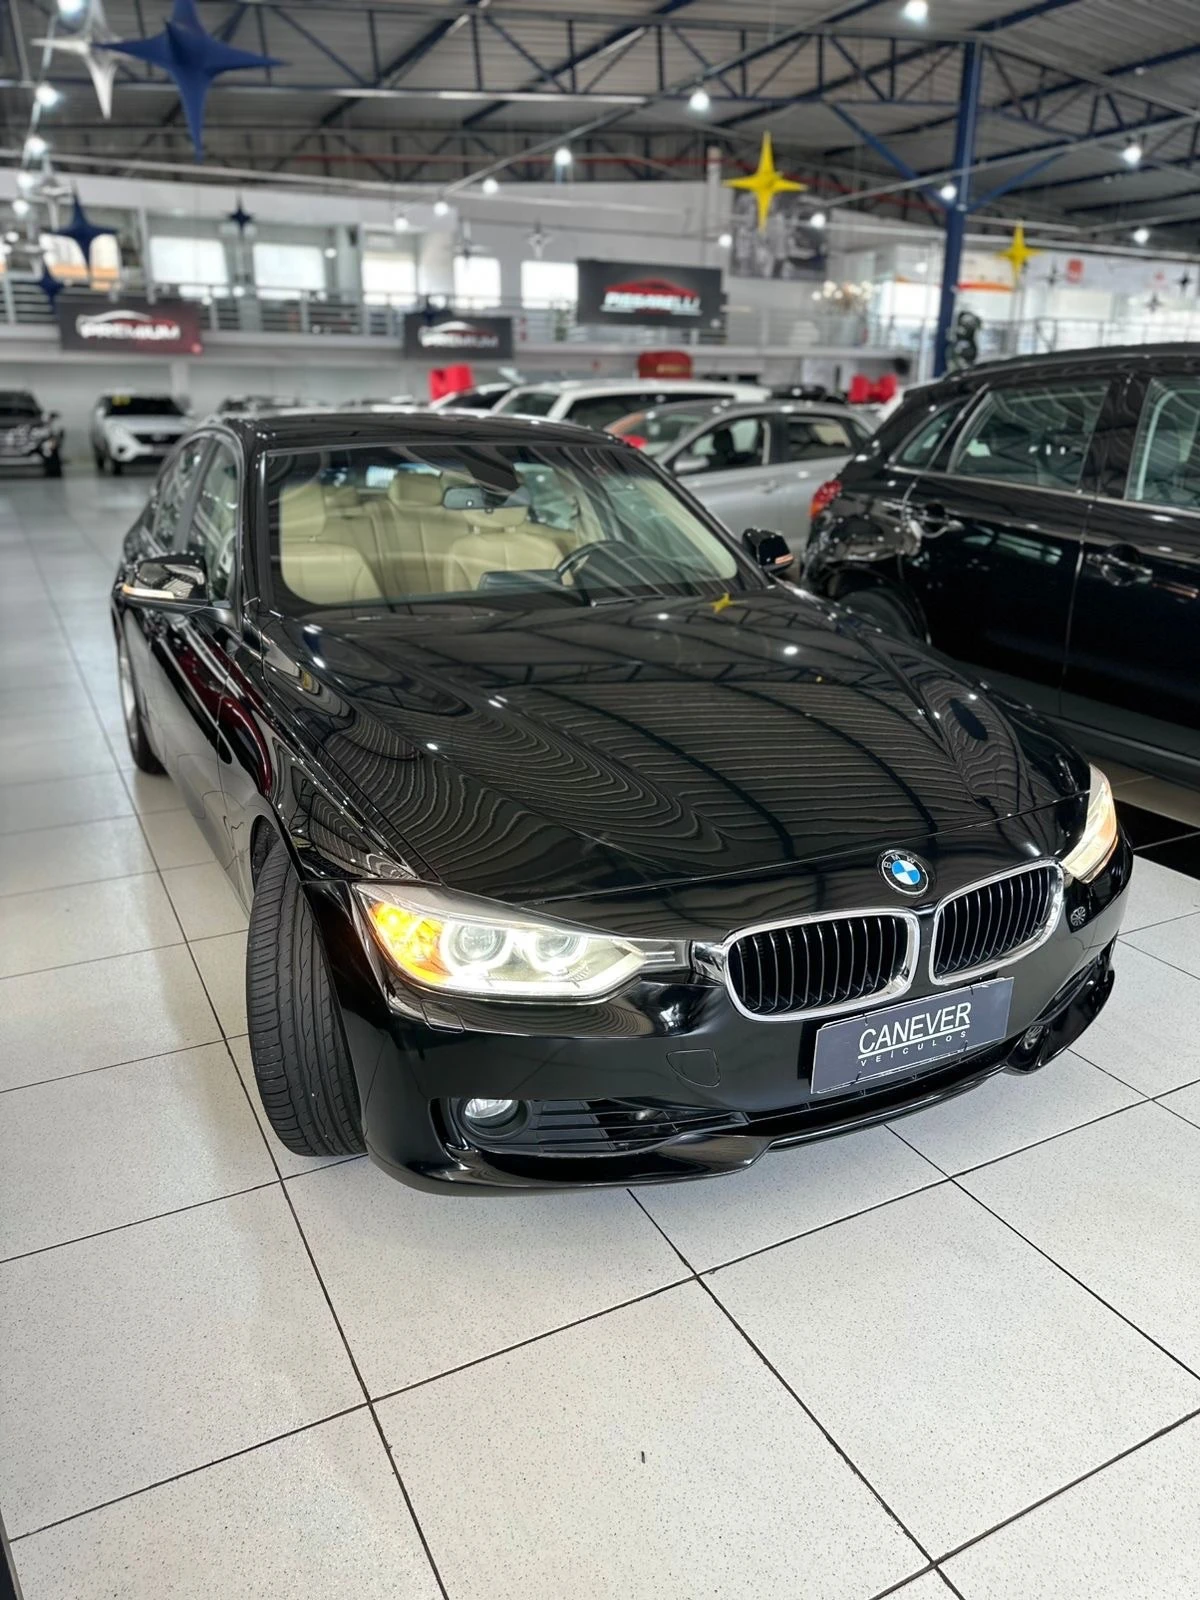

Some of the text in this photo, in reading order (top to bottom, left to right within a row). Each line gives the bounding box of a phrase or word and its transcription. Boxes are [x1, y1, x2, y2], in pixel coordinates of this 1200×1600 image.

[80, 321, 182, 341] PREMIUM
[421, 332, 499, 348] PREMIUM
[883, 853, 917, 869] BMW
[858, 1001, 972, 1054] CANEVER
